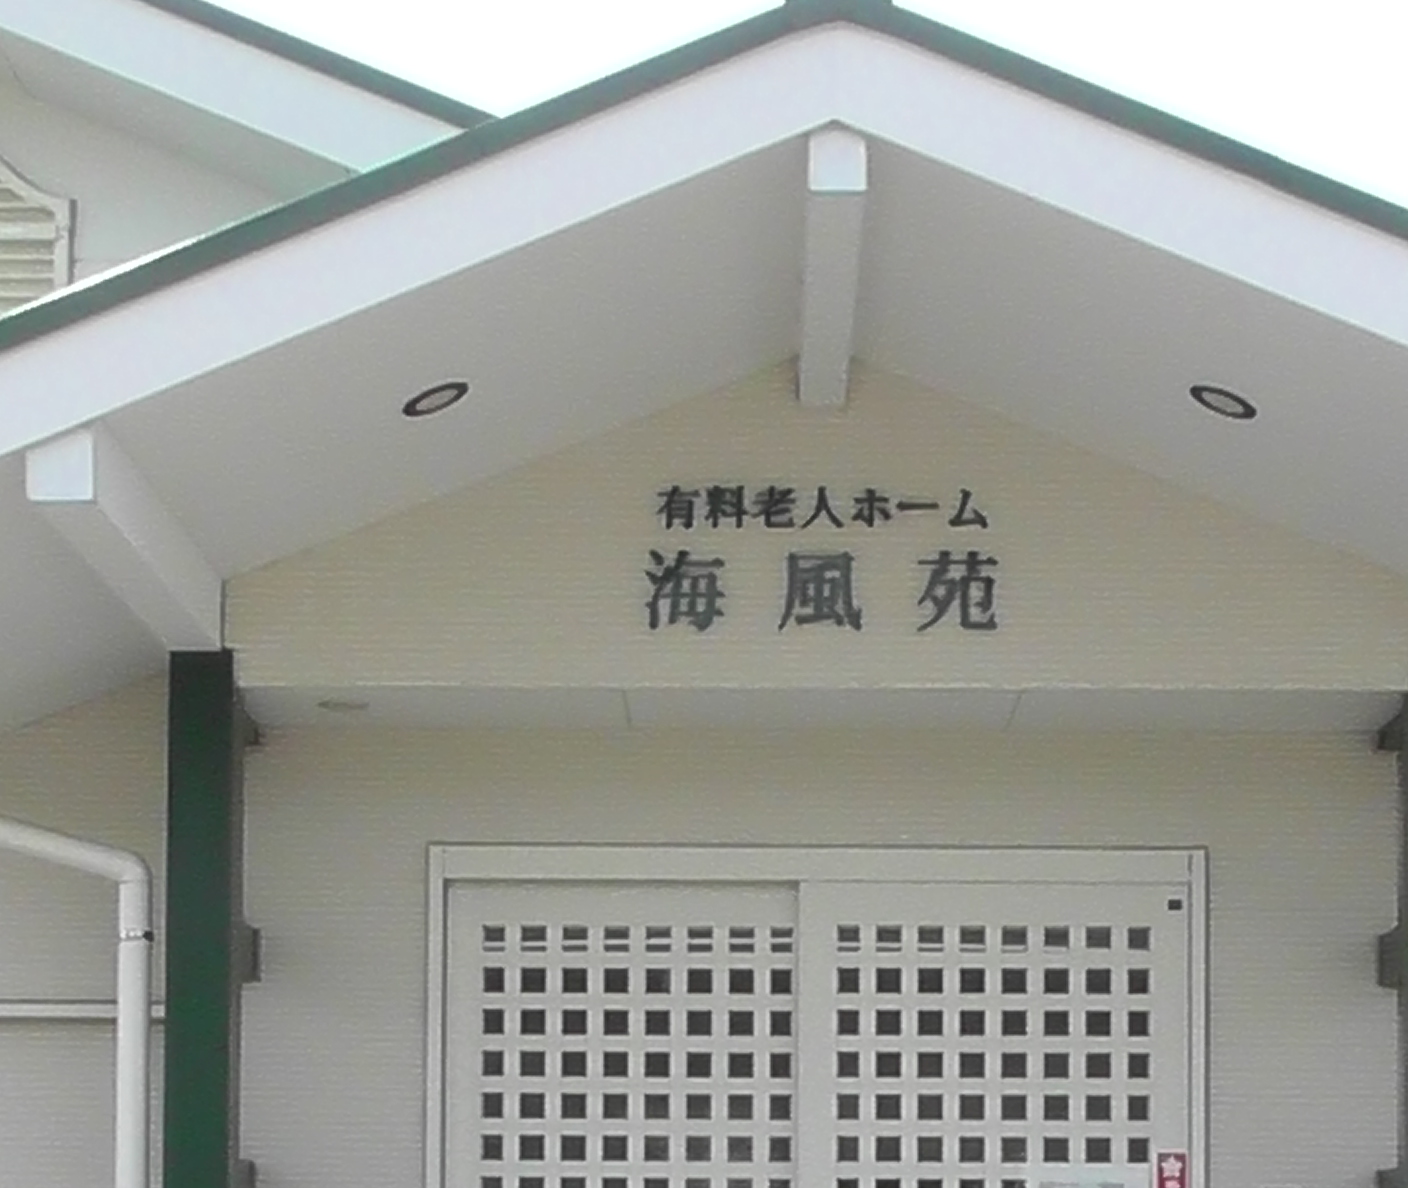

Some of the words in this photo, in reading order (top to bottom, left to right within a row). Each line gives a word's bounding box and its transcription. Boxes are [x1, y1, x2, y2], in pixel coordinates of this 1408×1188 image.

[656, 485, 989, 529] 有料老人ホーム
[645, 549, 999, 632] 海風苑
